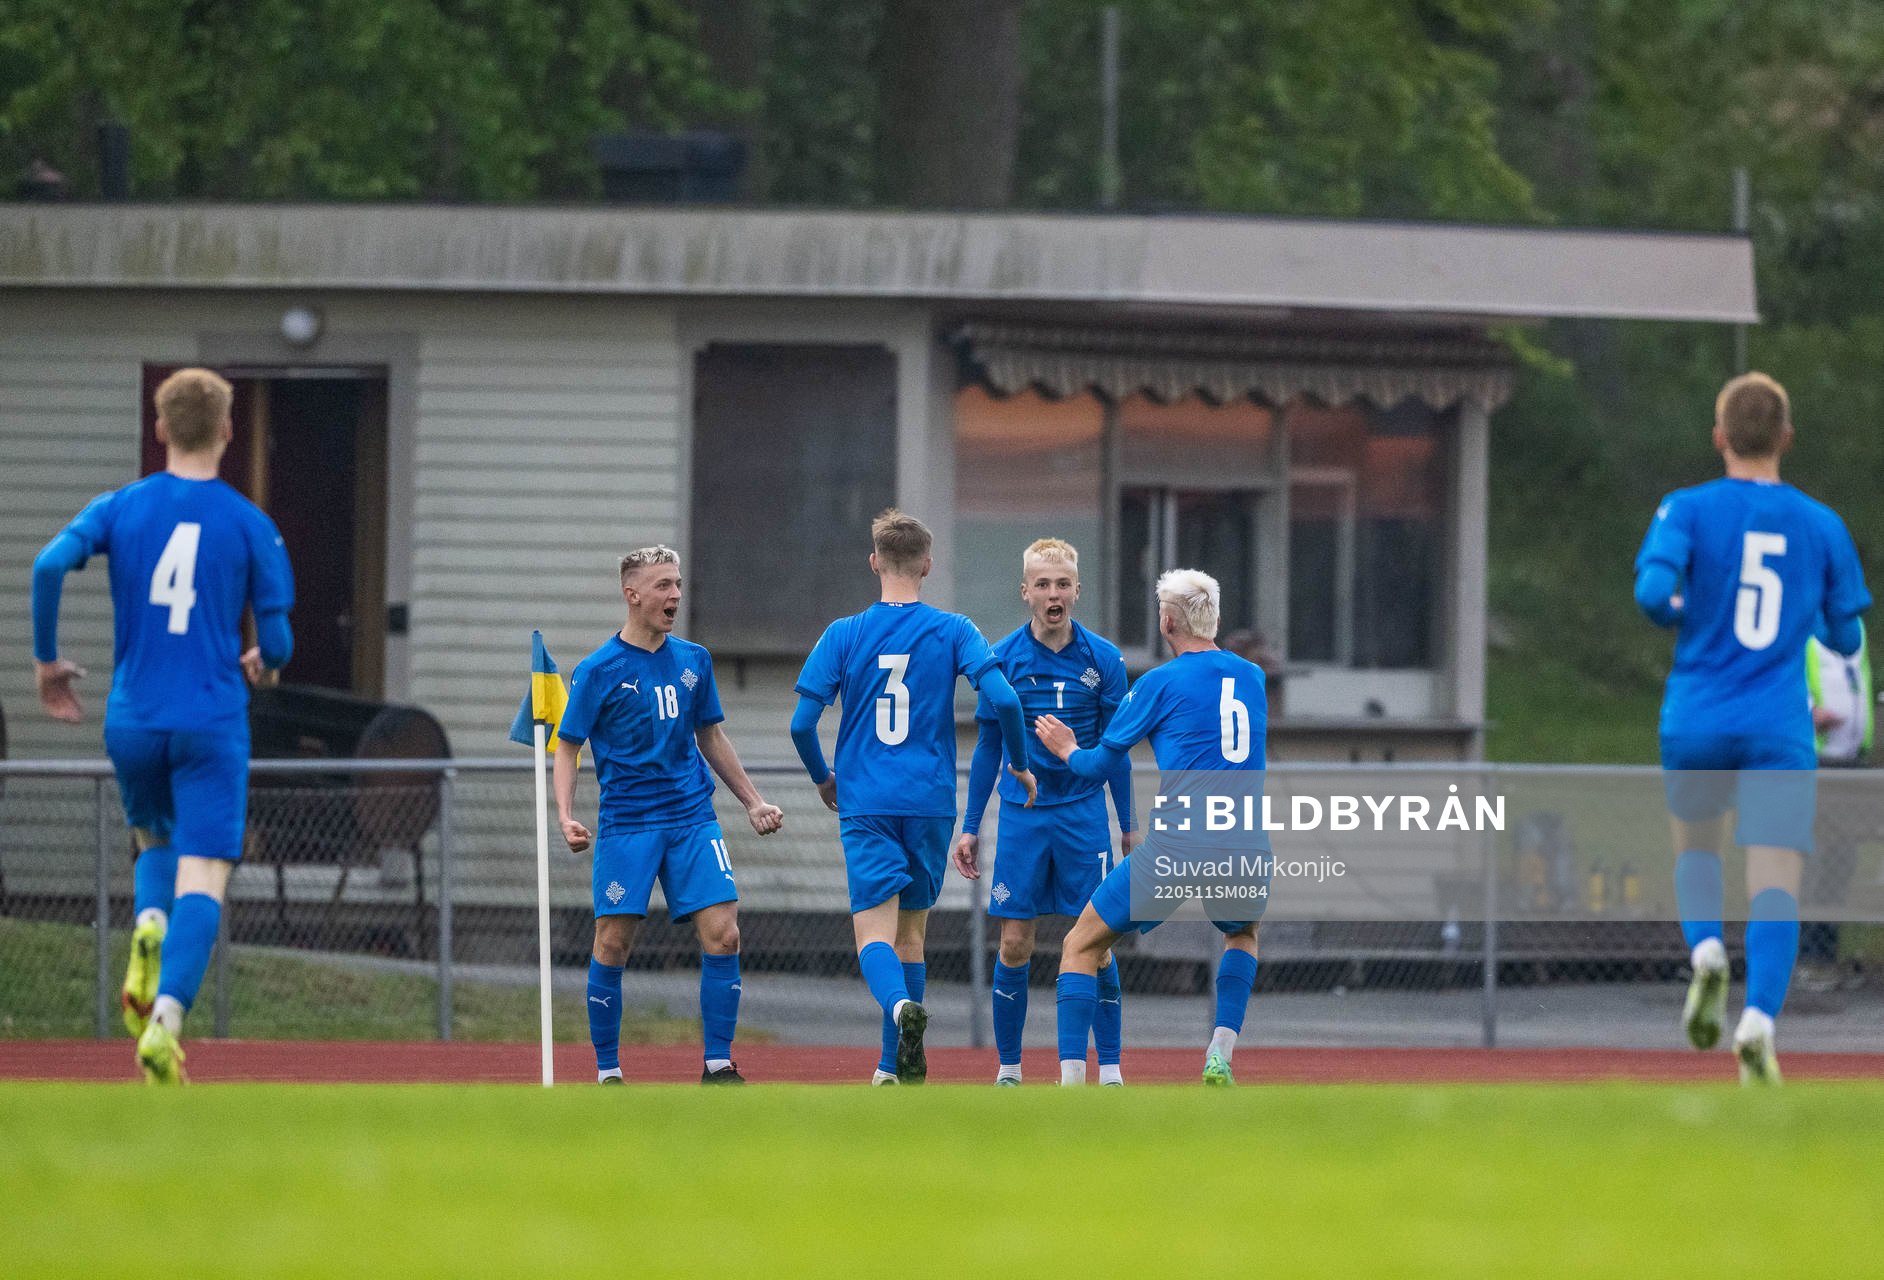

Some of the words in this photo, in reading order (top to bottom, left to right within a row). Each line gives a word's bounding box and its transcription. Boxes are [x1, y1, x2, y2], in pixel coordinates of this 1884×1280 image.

[150, 523, 201, 634] 4
[1734, 532, 1787, 650] 5
[654, 684, 680, 720] 18
[875, 654, 911, 746] 3
[1053, 682, 1066, 709] 7
[1219, 677, 1251, 764] 6
[1097, 851, 1108, 882] 7
